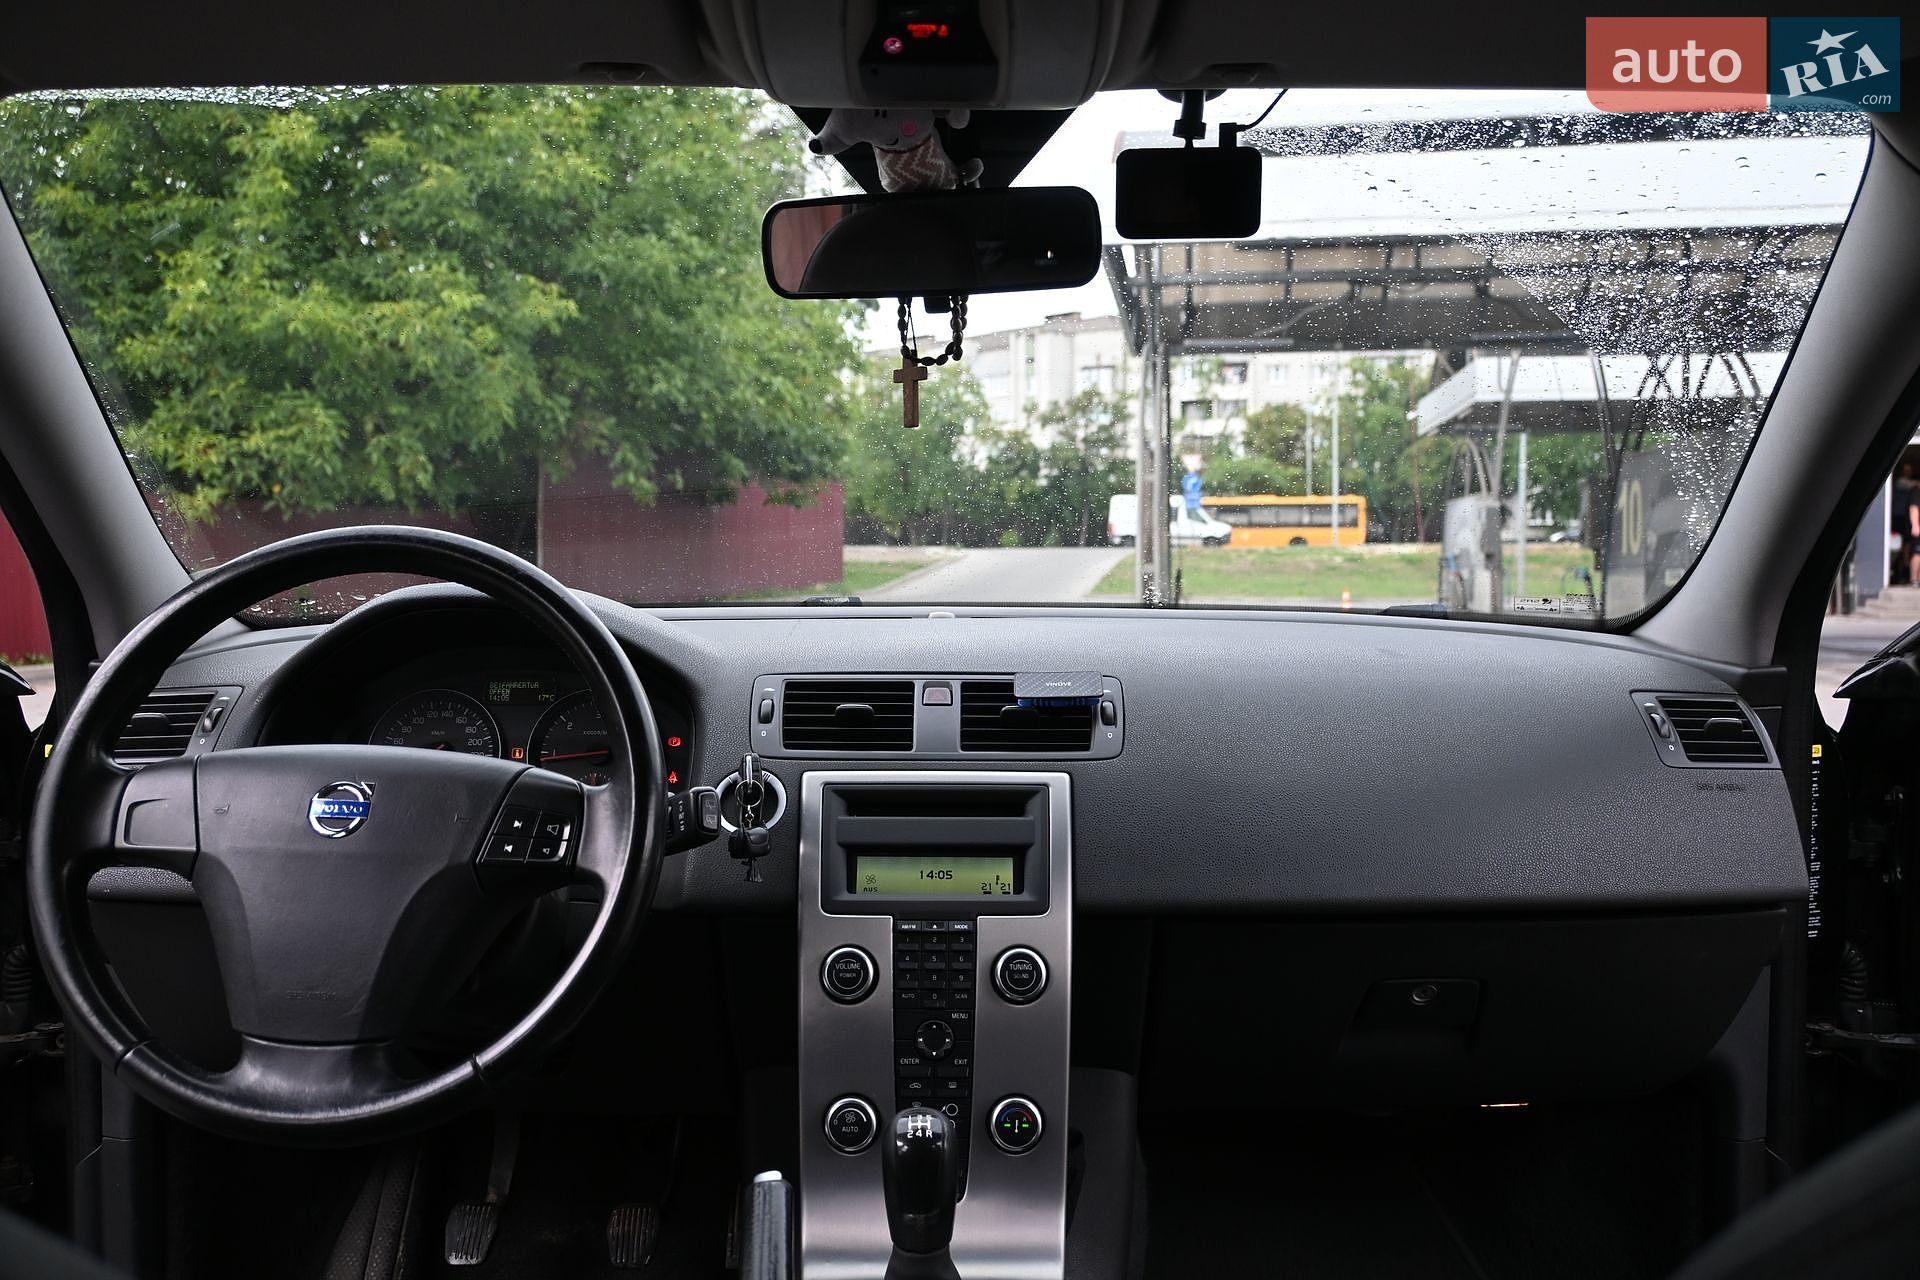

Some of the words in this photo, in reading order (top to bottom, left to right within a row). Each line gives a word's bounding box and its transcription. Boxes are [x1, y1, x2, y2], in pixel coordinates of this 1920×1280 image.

[1618, 480, 1643, 555] 10
[567, 722, 573, 730] 2
[318, 804, 363, 813] VOLVO
[920, 870, 953, 880] 14:05
[907, 1130, 914, 1138] 2
[926, 1130, 933, 1138] R
